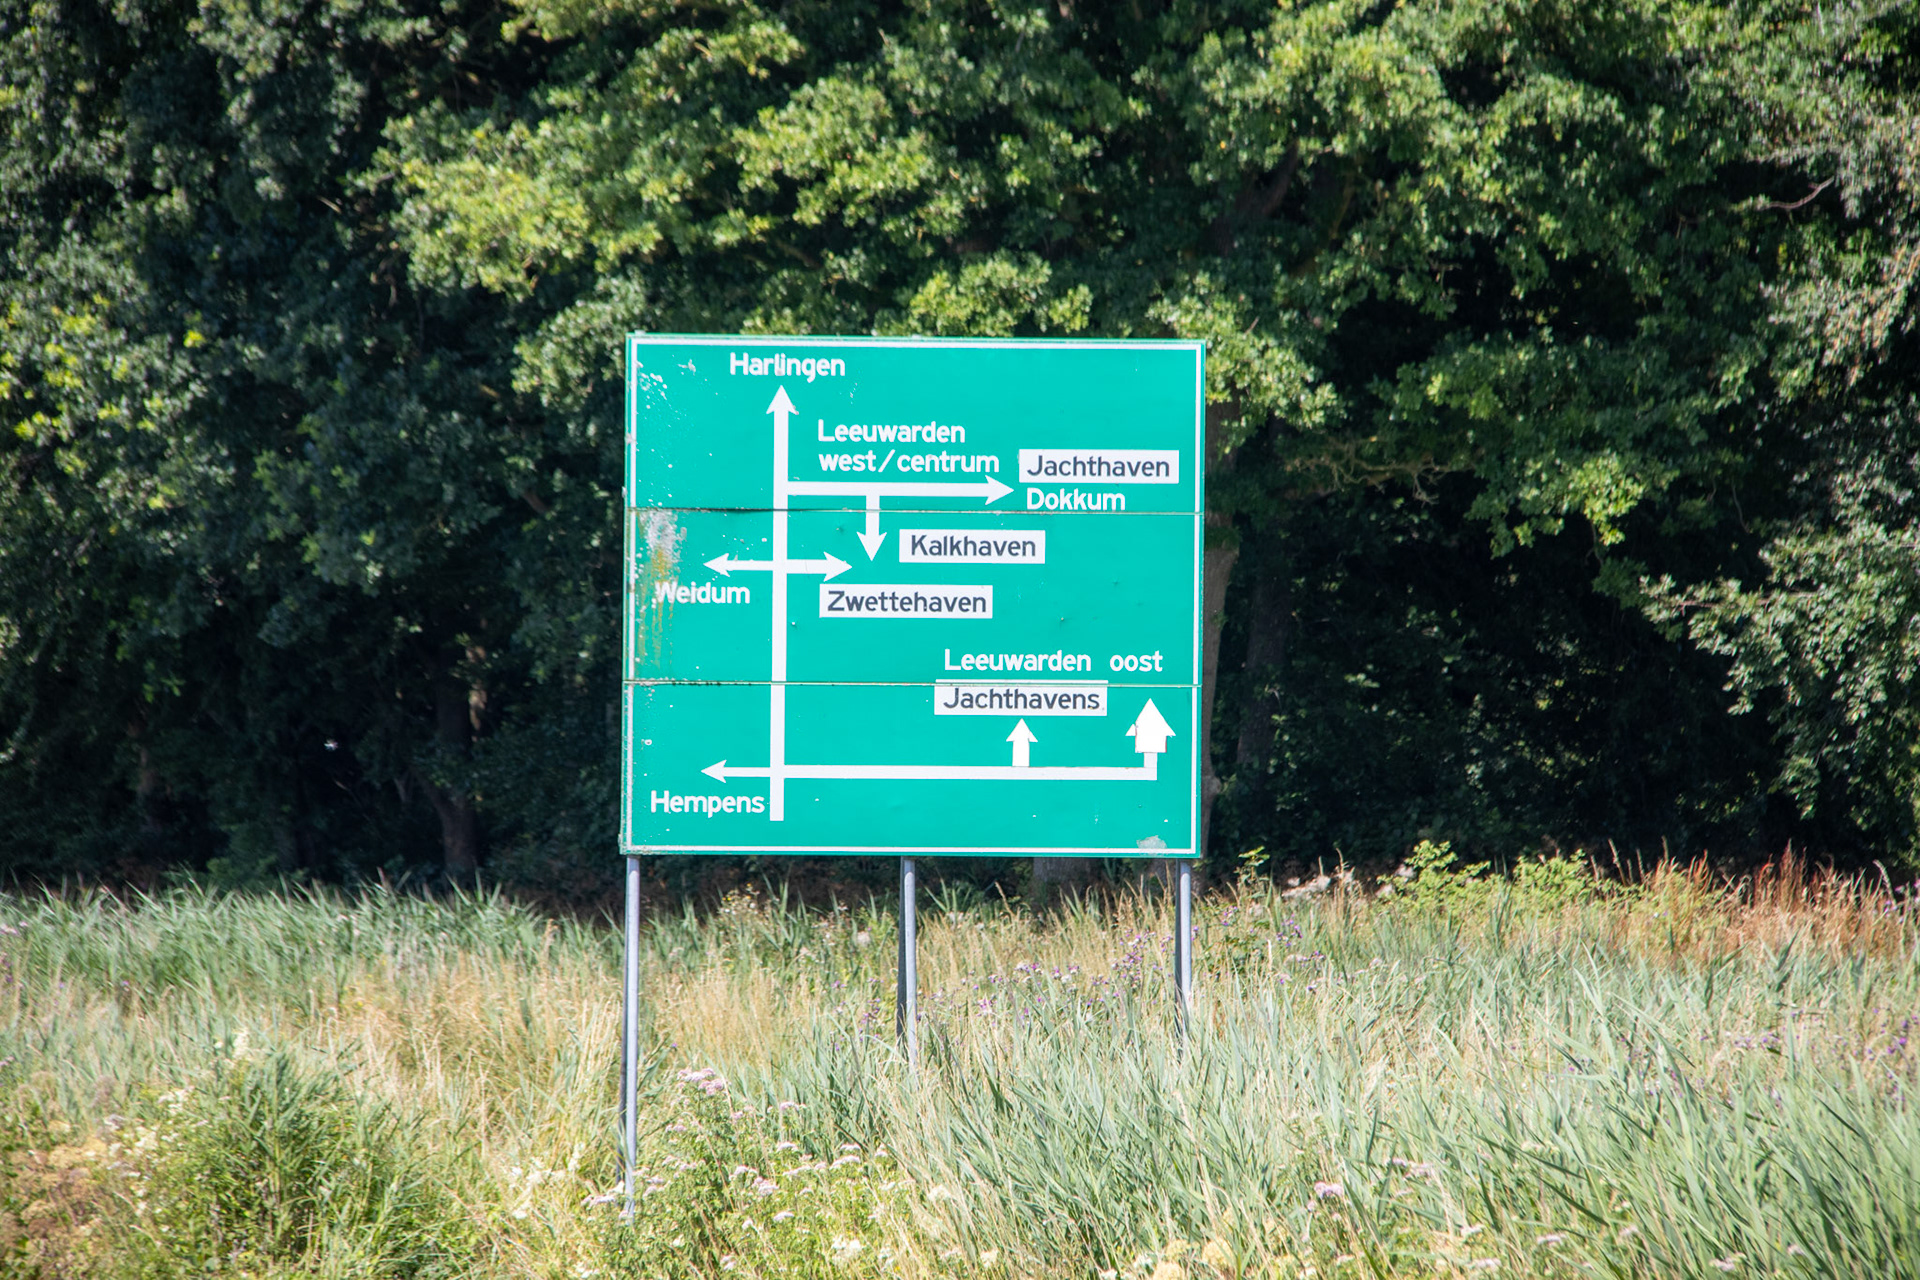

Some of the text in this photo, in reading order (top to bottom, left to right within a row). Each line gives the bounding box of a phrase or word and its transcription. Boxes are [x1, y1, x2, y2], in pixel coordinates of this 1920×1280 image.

[729, 352, 845, 382] Harlingen
[817, 419, 966, 443] Leeuwarden
[1026, 455, 1170, 477] Jachthaven
[1026, 487, 1127, 512] Dokkum
[910, 534, 1037, 558] Kalkhaven
[655, 581, 750, 604] Weidum
[827, 590, 987, 613] Zwettehaven
[944, 648, 1164, 673] Leeuwarden oost
[943, 687, 1100, 710] Jachthavens
[650, 789, 766, 819] Hempens
